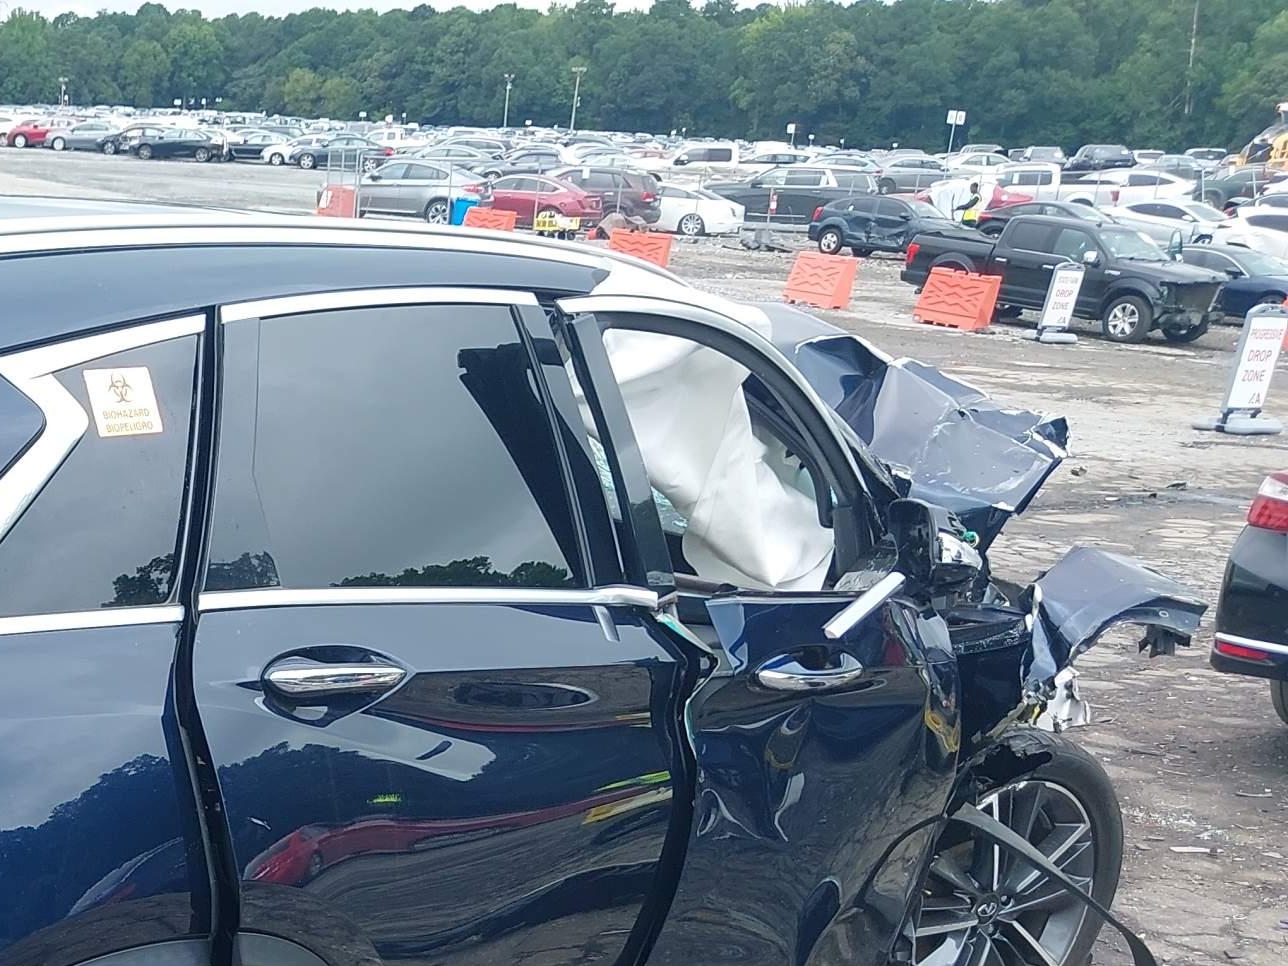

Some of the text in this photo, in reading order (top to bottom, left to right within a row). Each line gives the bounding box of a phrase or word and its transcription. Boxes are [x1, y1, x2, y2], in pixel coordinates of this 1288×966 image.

[1247, 350, 1272, 362] DROP
[1242, 369, 1267, 382] ZONE
[103, 408, 150, 420] BIOHAZARD
[106, 421, 154, 433] BIOPELIGRO
